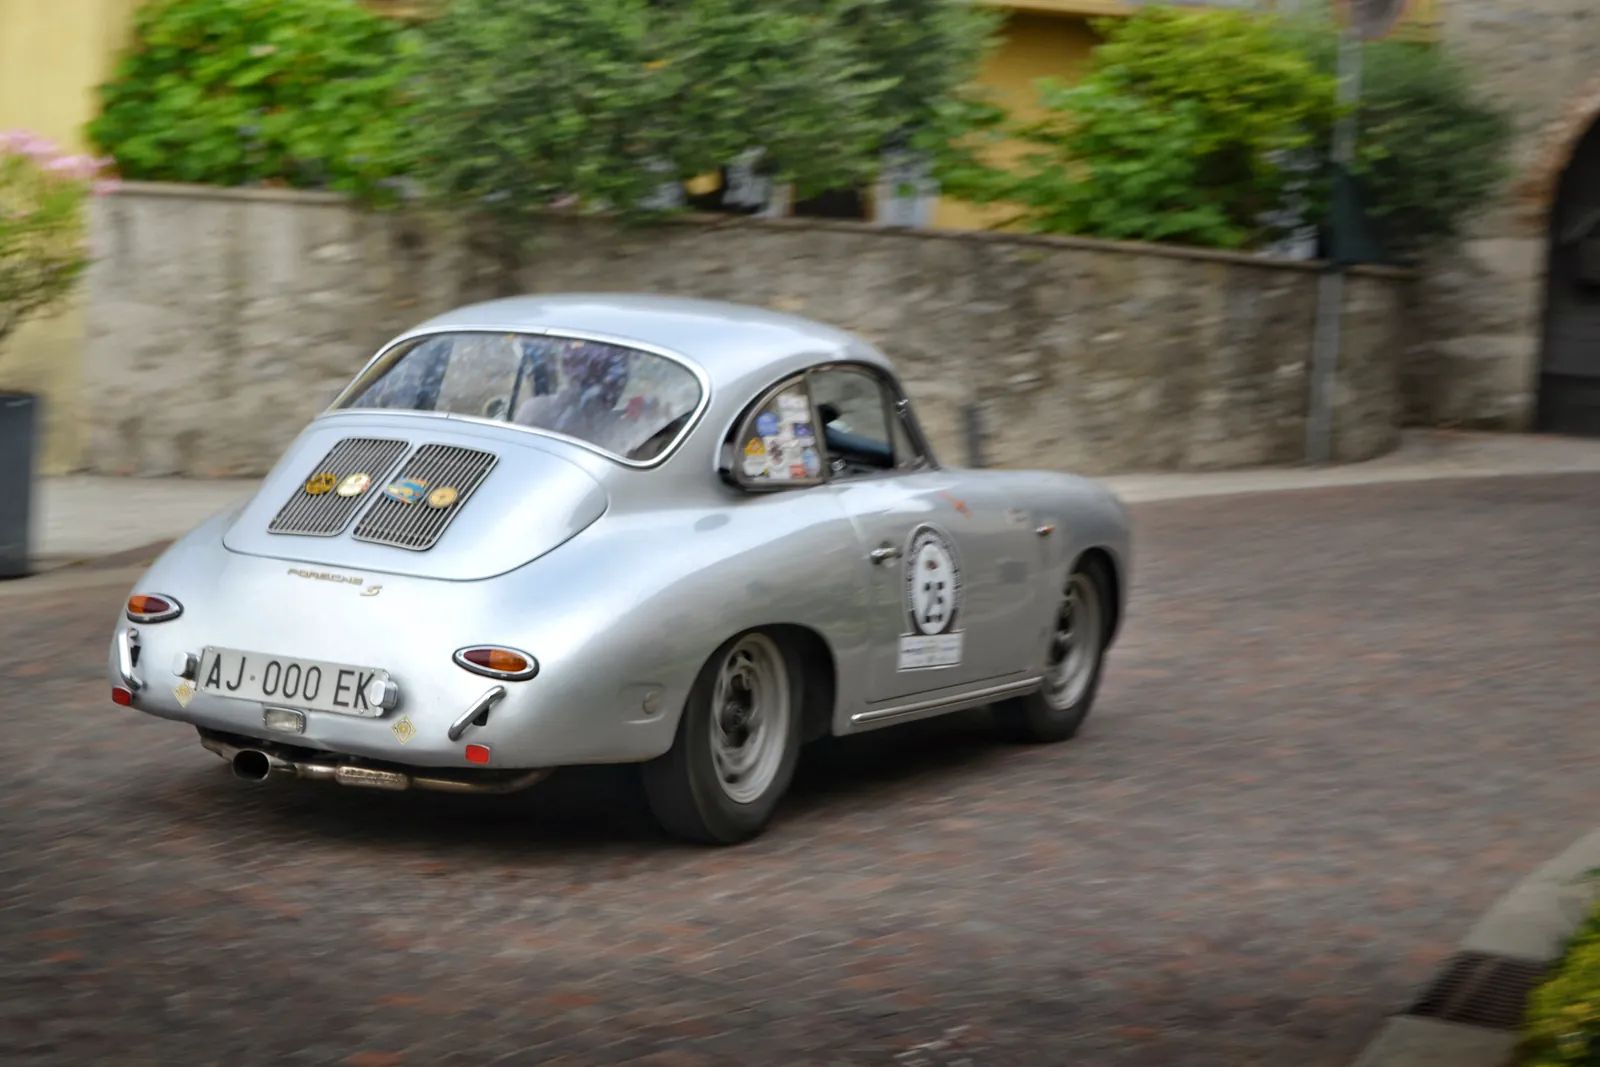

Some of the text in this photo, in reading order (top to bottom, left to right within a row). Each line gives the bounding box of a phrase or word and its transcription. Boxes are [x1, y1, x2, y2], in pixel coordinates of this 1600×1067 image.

[287, 568, 364, 586] PORSCHE
[359, 584, 383, 597] S
[205, 653, 376, 710] AJ 000 EK
